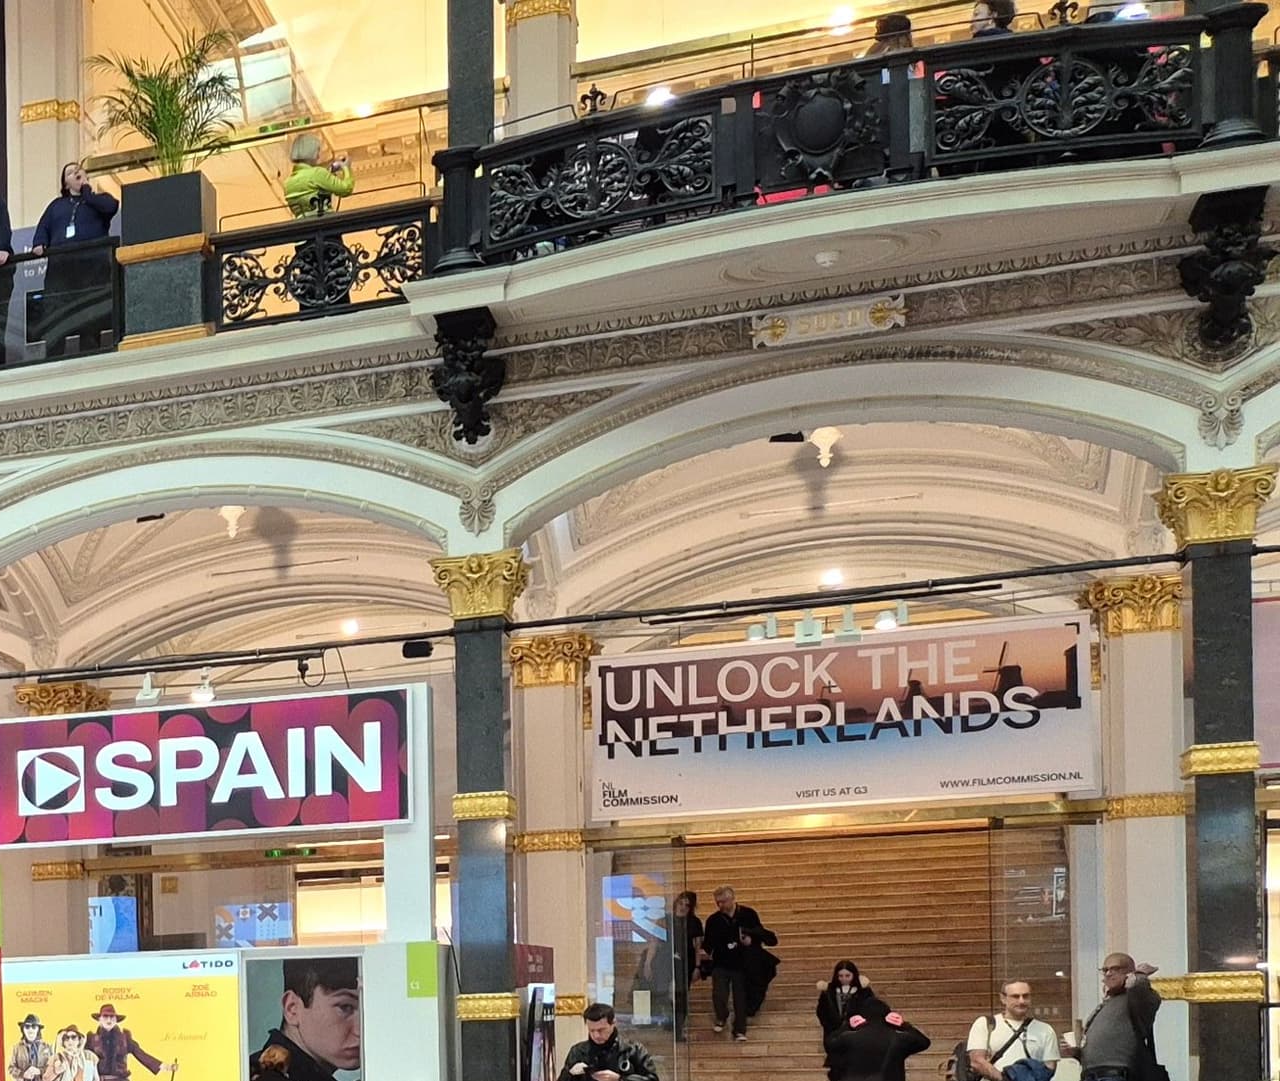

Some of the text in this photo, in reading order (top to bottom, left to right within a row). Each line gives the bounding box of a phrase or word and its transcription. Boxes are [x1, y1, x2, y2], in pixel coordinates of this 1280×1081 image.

[605, 639, 978, 712] UNLOCK THE
[606, 685, 1041, 760] NETHERLANDS
[94, 721, 382, 811] SPAIN
[940, 772, 1083, 790] WWW.FILMCOMMISSION.NL
[603, 790, 628, 798] FILM
[603, 794, 678, 808] COMMISSION
[796, 786, 868, 799] VISIT US AT G3
